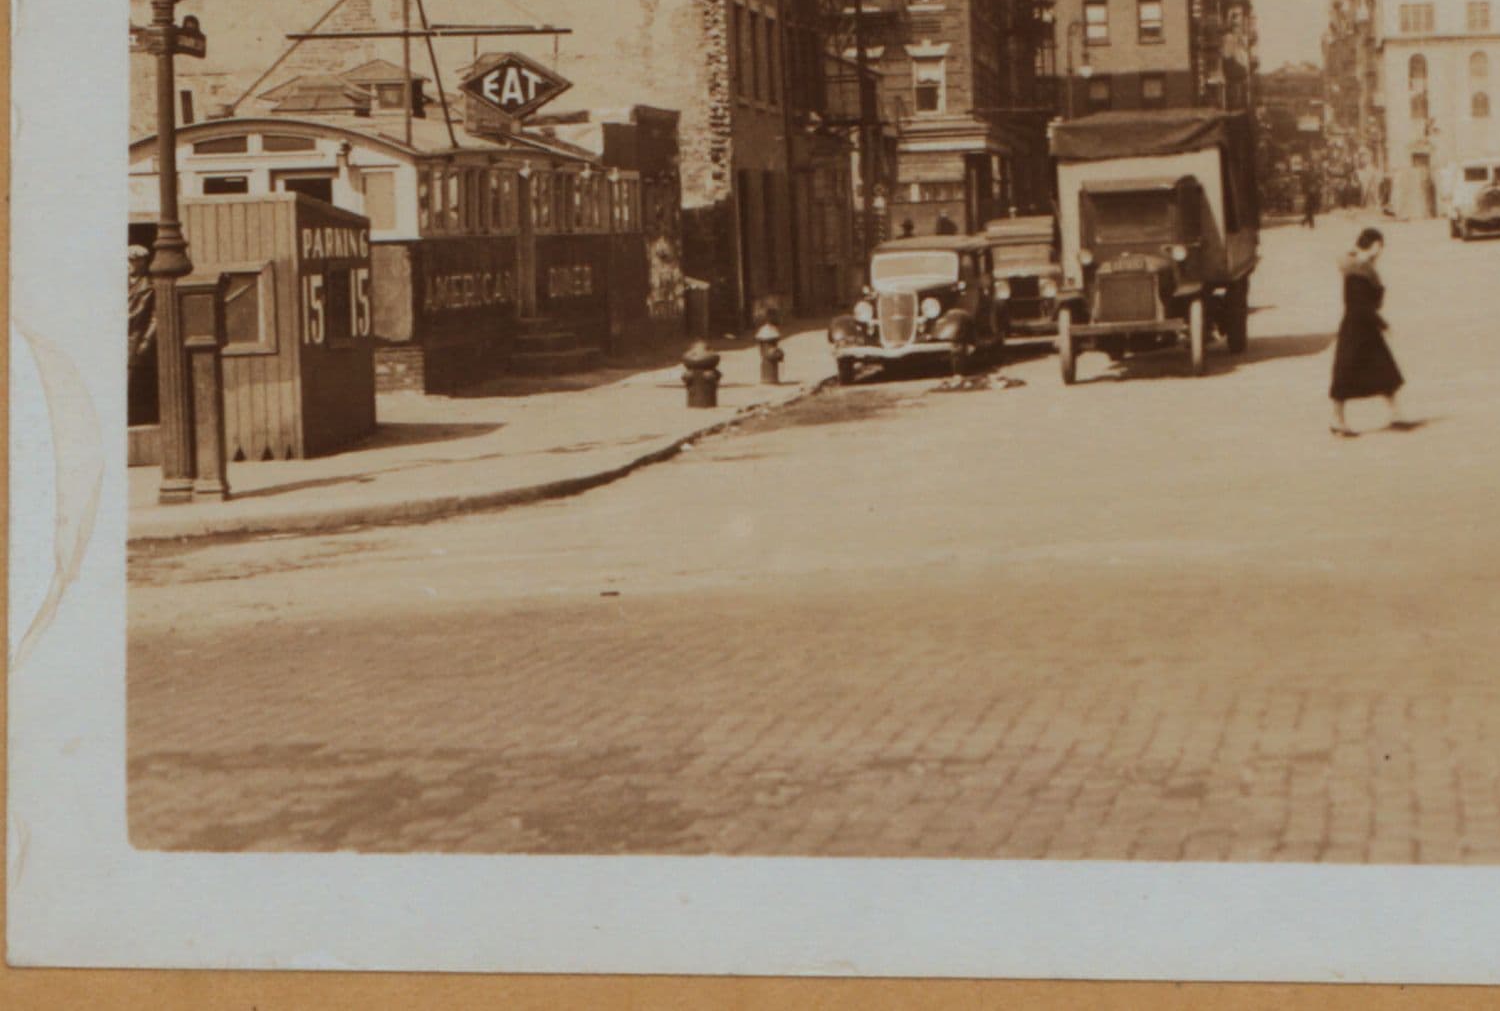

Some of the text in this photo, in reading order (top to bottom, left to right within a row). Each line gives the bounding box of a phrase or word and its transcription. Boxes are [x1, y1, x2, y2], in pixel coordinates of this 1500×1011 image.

[482, 67, 543, 105] EAT
[303, 274, 325, 344] 15
[350, 267, 370, 337] 15
